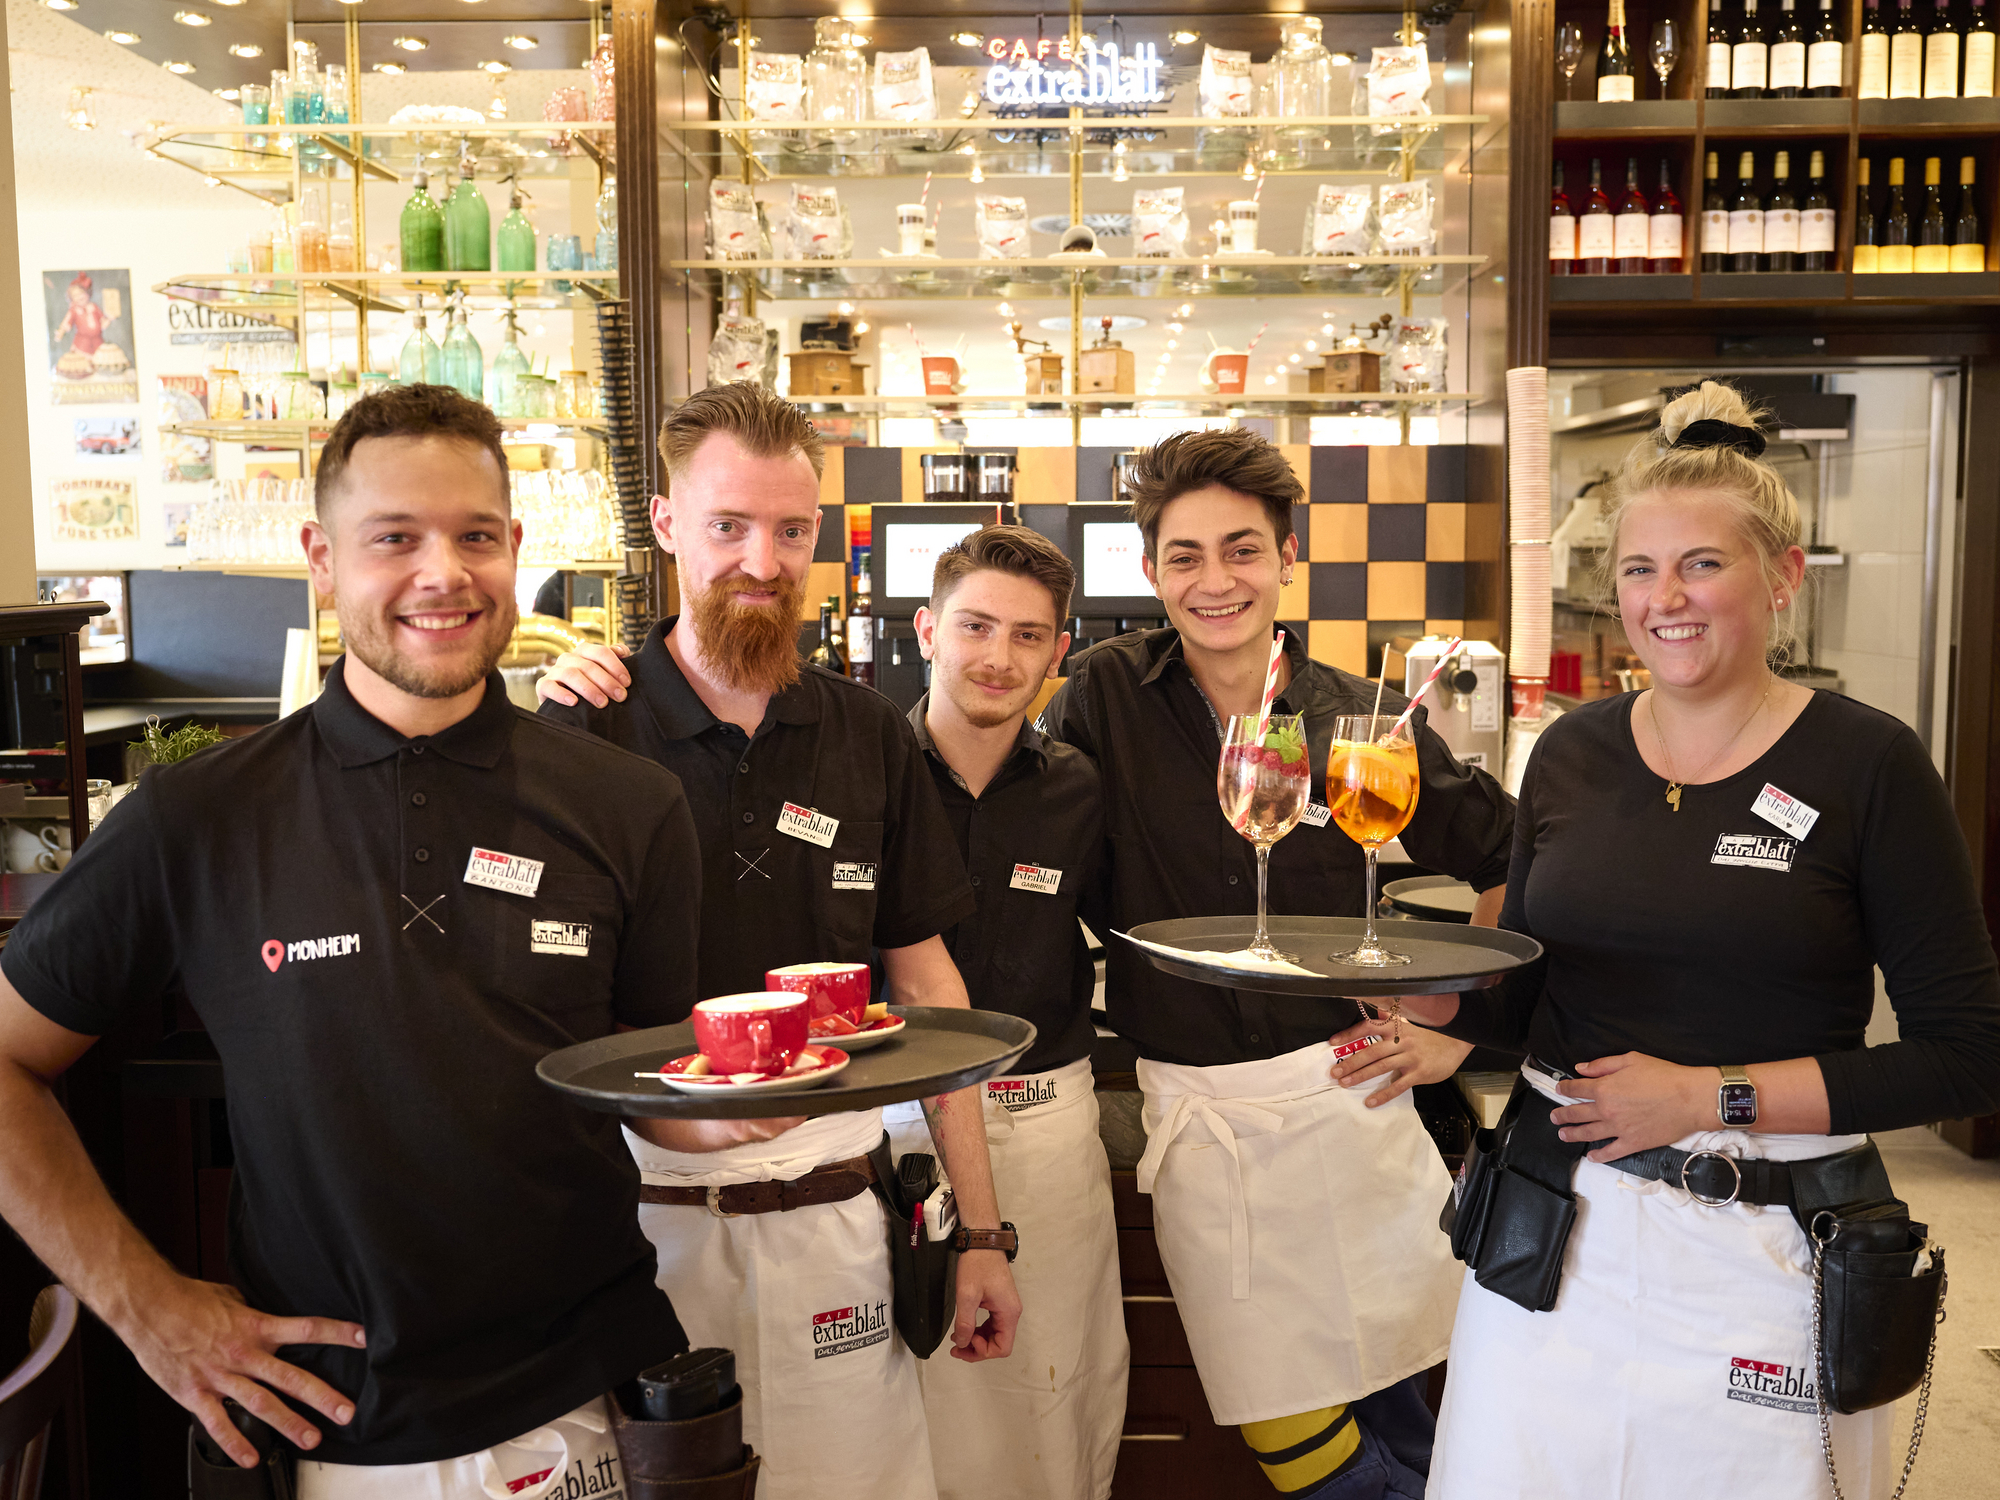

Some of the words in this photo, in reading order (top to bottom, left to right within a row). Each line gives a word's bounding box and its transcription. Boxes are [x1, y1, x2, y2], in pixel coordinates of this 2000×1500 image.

[986, 41, 1165, 104] extrablatt
[102, 525, 134, 540] TEA
[1759, 792, 1813, 829] extrablatt
[781, 810, 834, 837] extrablatt
[1717, 838, 1794, 860] extrablatt
[472, 857, 537, 884] extrablatt
[834, 864, 875, 881] extrablatt
[1013, 869, 1058, 885] extrablatt
[1020, 881, 1048, 891] GABRIEL
[533, 924, 589, 946] extrablatt
[287, 933, 360, 962] MONHEIM
[988, 1078, 1058, 1104] extrablatt
[813, 1299, 888, 1344] extrablatt
[1729, 1366, 1815, 1400] extrabla
[1730, 1390, 1751, 1402] Das
[1750, 1396, 1795, 1410] gewisse
[508, 1473, 545, 1493] CAF
